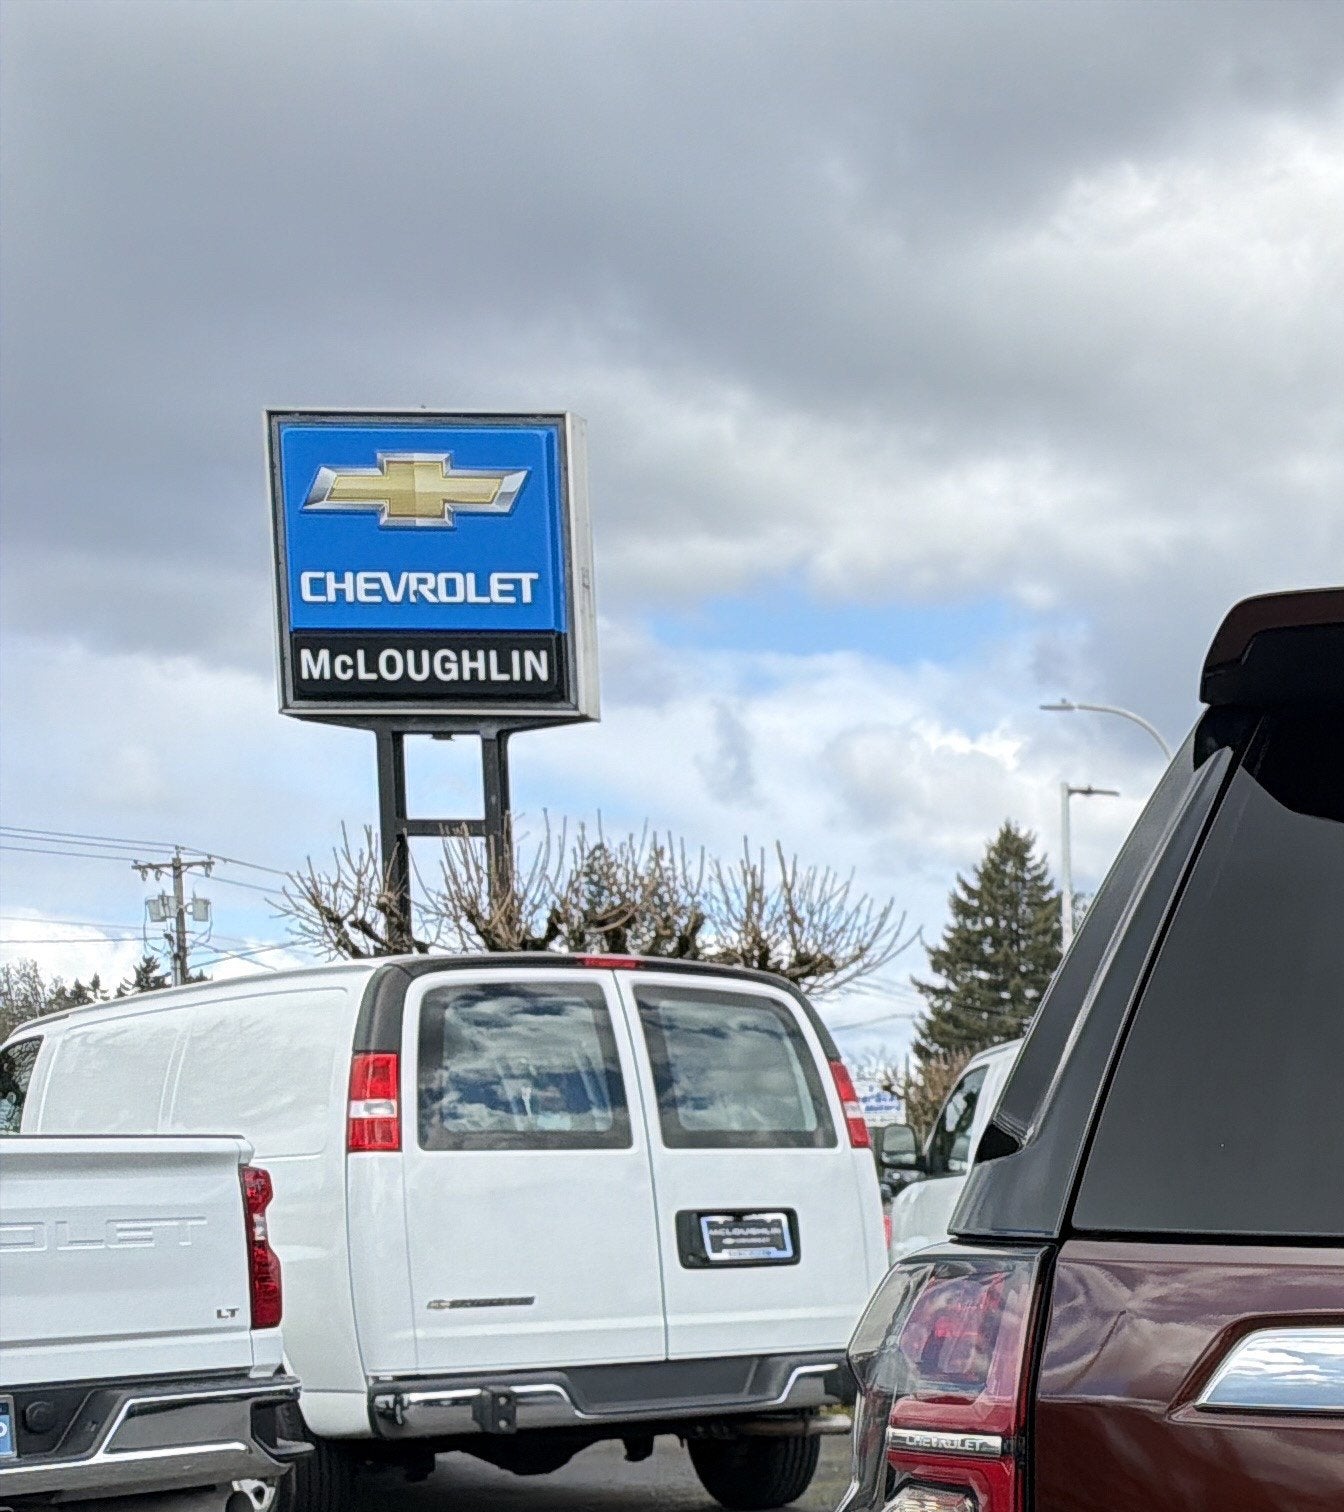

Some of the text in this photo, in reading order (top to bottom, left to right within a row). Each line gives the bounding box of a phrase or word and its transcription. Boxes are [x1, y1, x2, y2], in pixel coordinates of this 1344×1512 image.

[300, 571, 539, 604] CHEVROLET
[300, 648, 549, 682] McLOUGHLIN
[216, 1307, 240, 1319] LT
